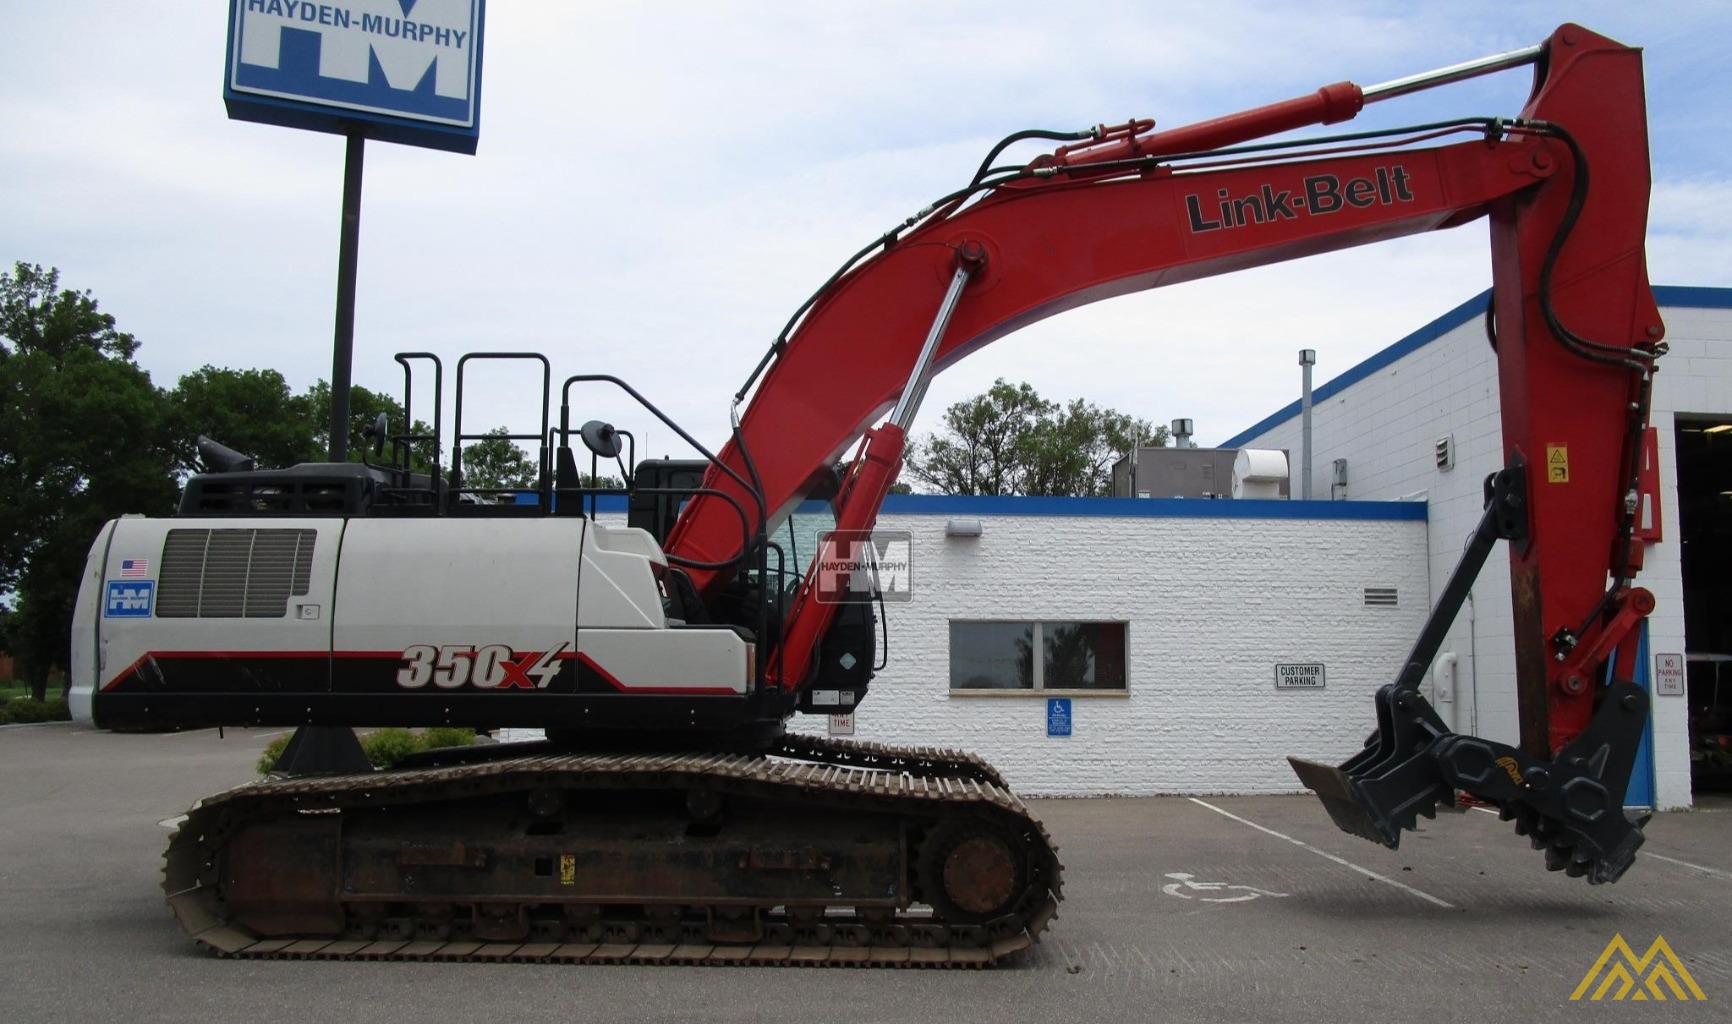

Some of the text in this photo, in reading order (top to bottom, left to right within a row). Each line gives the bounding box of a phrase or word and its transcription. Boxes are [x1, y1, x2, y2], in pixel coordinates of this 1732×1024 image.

[248, 0, 467, 49] HAYDEN-MURPHY
[1185, 165, 1415, 234] Link-Belt
[109, 588, 150, 610] HM
[1664, 659, 1674, 668] NO
[1280, 666, 1320, 676] CUSTOMER
[1657, 669, 1682, 677] PARKING
[1285, 676, 1316, 685] PARKING
[834, 719, 850, 727] TIME
